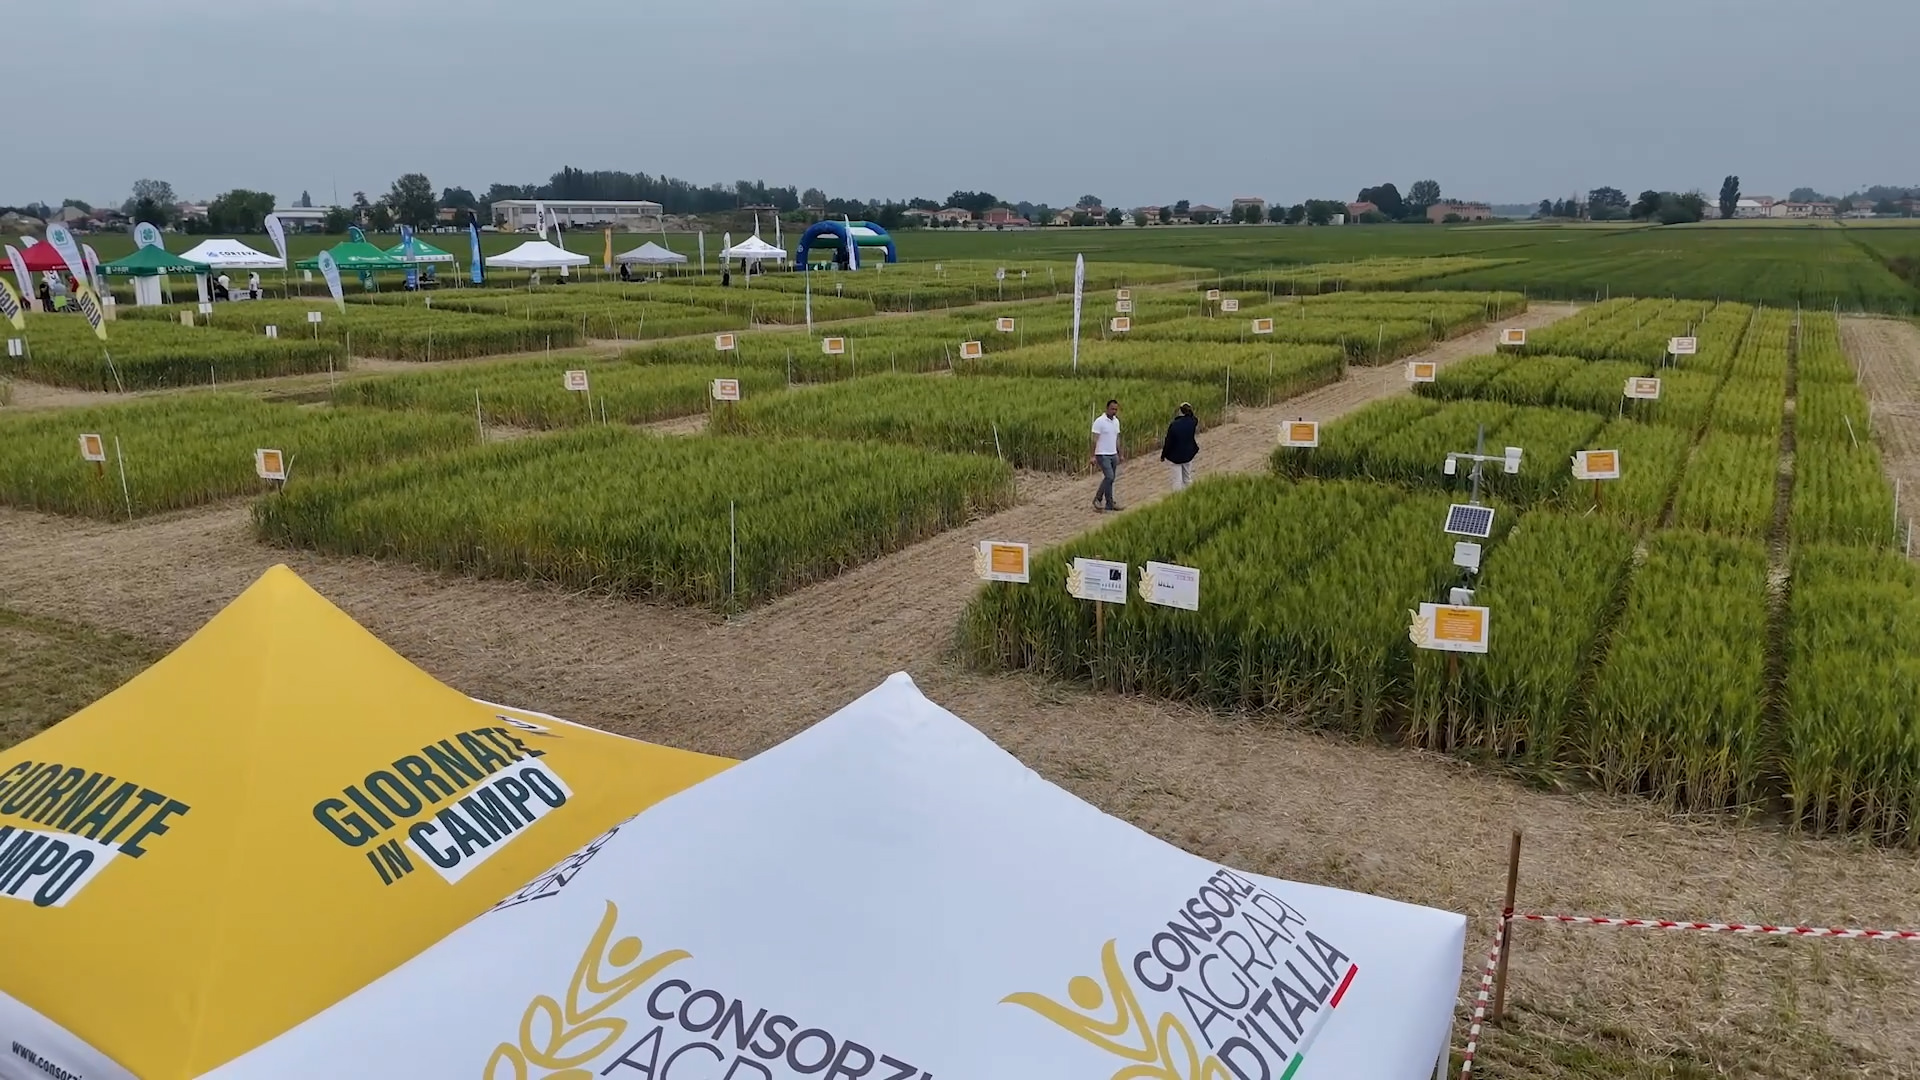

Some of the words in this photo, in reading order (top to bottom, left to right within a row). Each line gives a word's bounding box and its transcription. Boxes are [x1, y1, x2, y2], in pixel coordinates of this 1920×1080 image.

[312, 727, 547, 847] GIORNATE
[366, 838, 414, 886] IN
[408, 767, 567, 868] CAMPO
[1133, 868, 1256, 992] CONSORZI
[1176, 888, 1307, 1050] AGRARI
[647, 979, 933, 1080] CONSORZ
